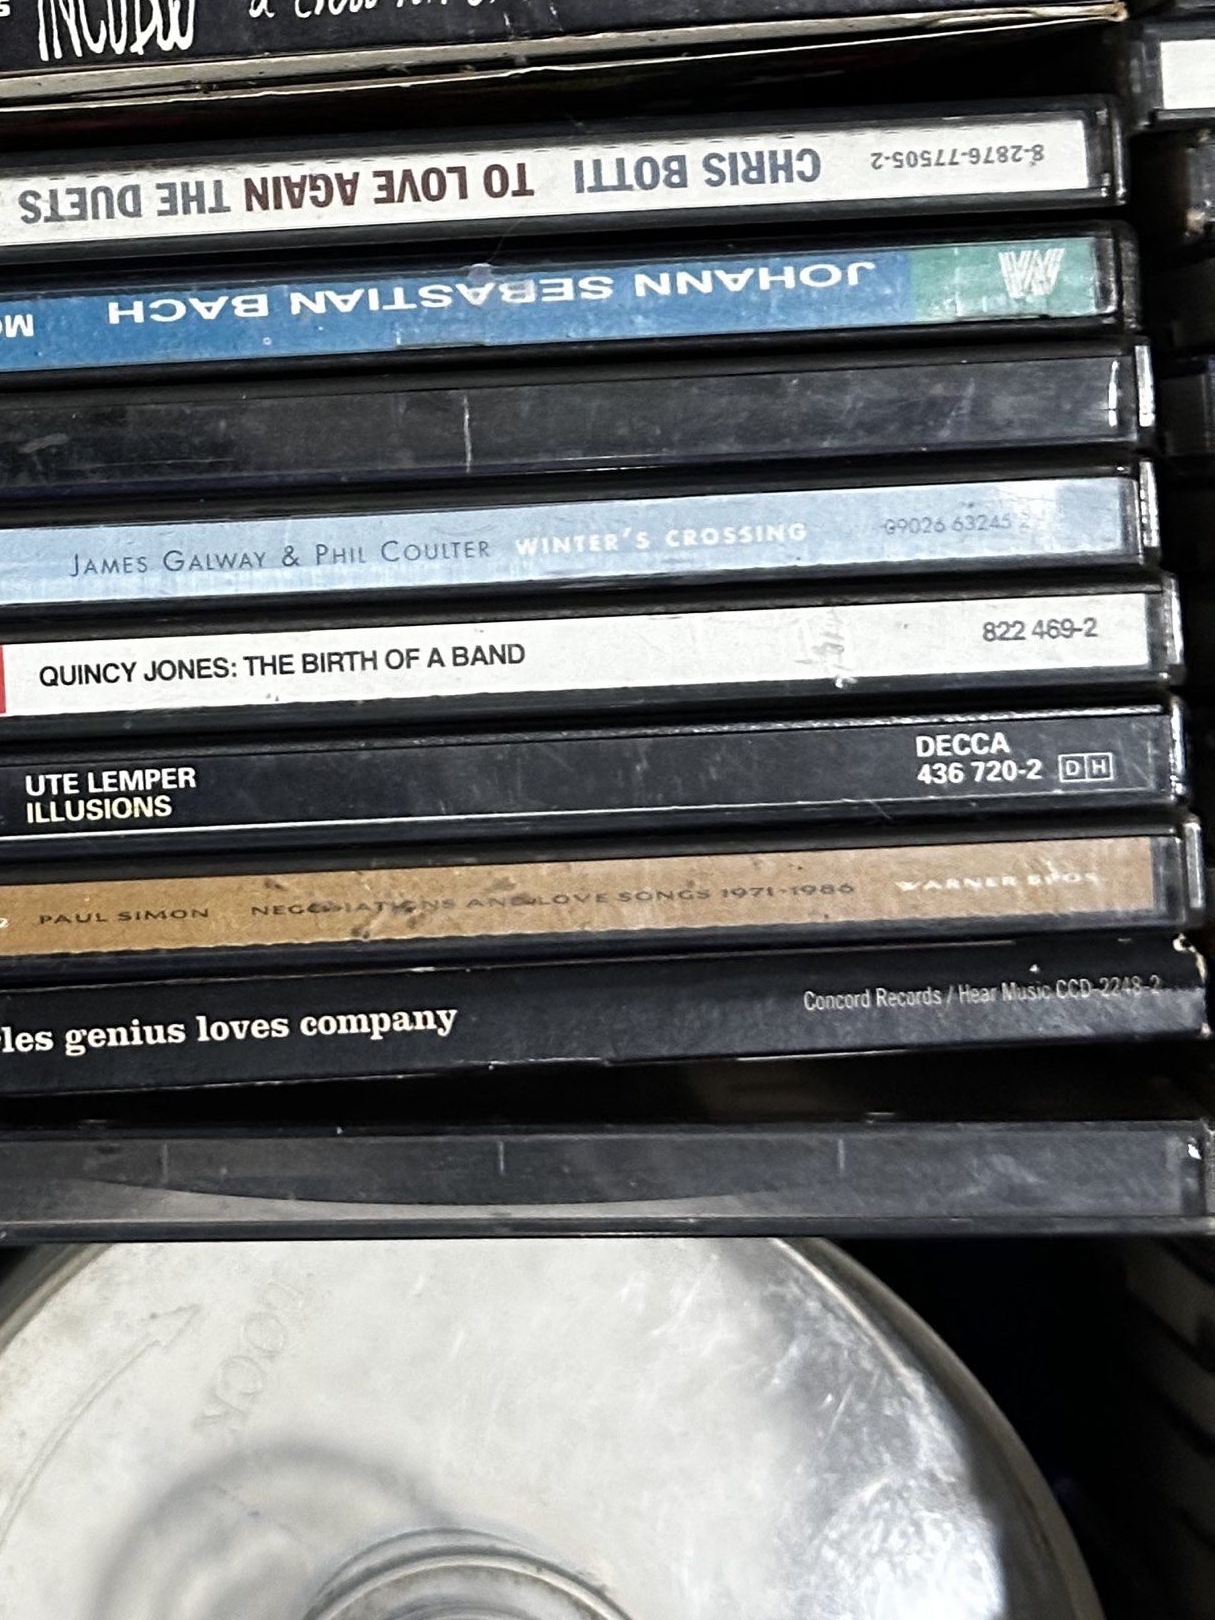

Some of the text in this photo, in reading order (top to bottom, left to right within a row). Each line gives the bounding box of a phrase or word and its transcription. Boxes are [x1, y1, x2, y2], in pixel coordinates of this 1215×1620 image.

[870, 143, 1045, 171] 8-2876-77505-2
[18, 148, 822, 225] CHRIS BOTTI TO LOVE AGAIN THE DUETS
[108, 261, 876, 325] JOHANN SEBASTIAN BACH
[515, 522, 807, 556] WINTER'S CROSSING
[69, 540, 490, 578] JAMES GALWAY & PHIL COULTER
[982, 616, 1099, 643] 822 469-2
[39, 643, 526, 687] QUINCY JONES: THE BIRTH OF A BAND
[915, 731, 1011, 758] DECCA
[25, 767, 196, 797] UTE LEMPER
[917, 758, 1043, 785] 436 720-2
[26, 795, 172, 824] ILLUSIONS
[39, 908, 209, 925] PAUL SIMON
[65, 1018, 186, 1057] genius
[195, 1015, 290, 1042] loves
[299, 1009, 458, 1041] company
